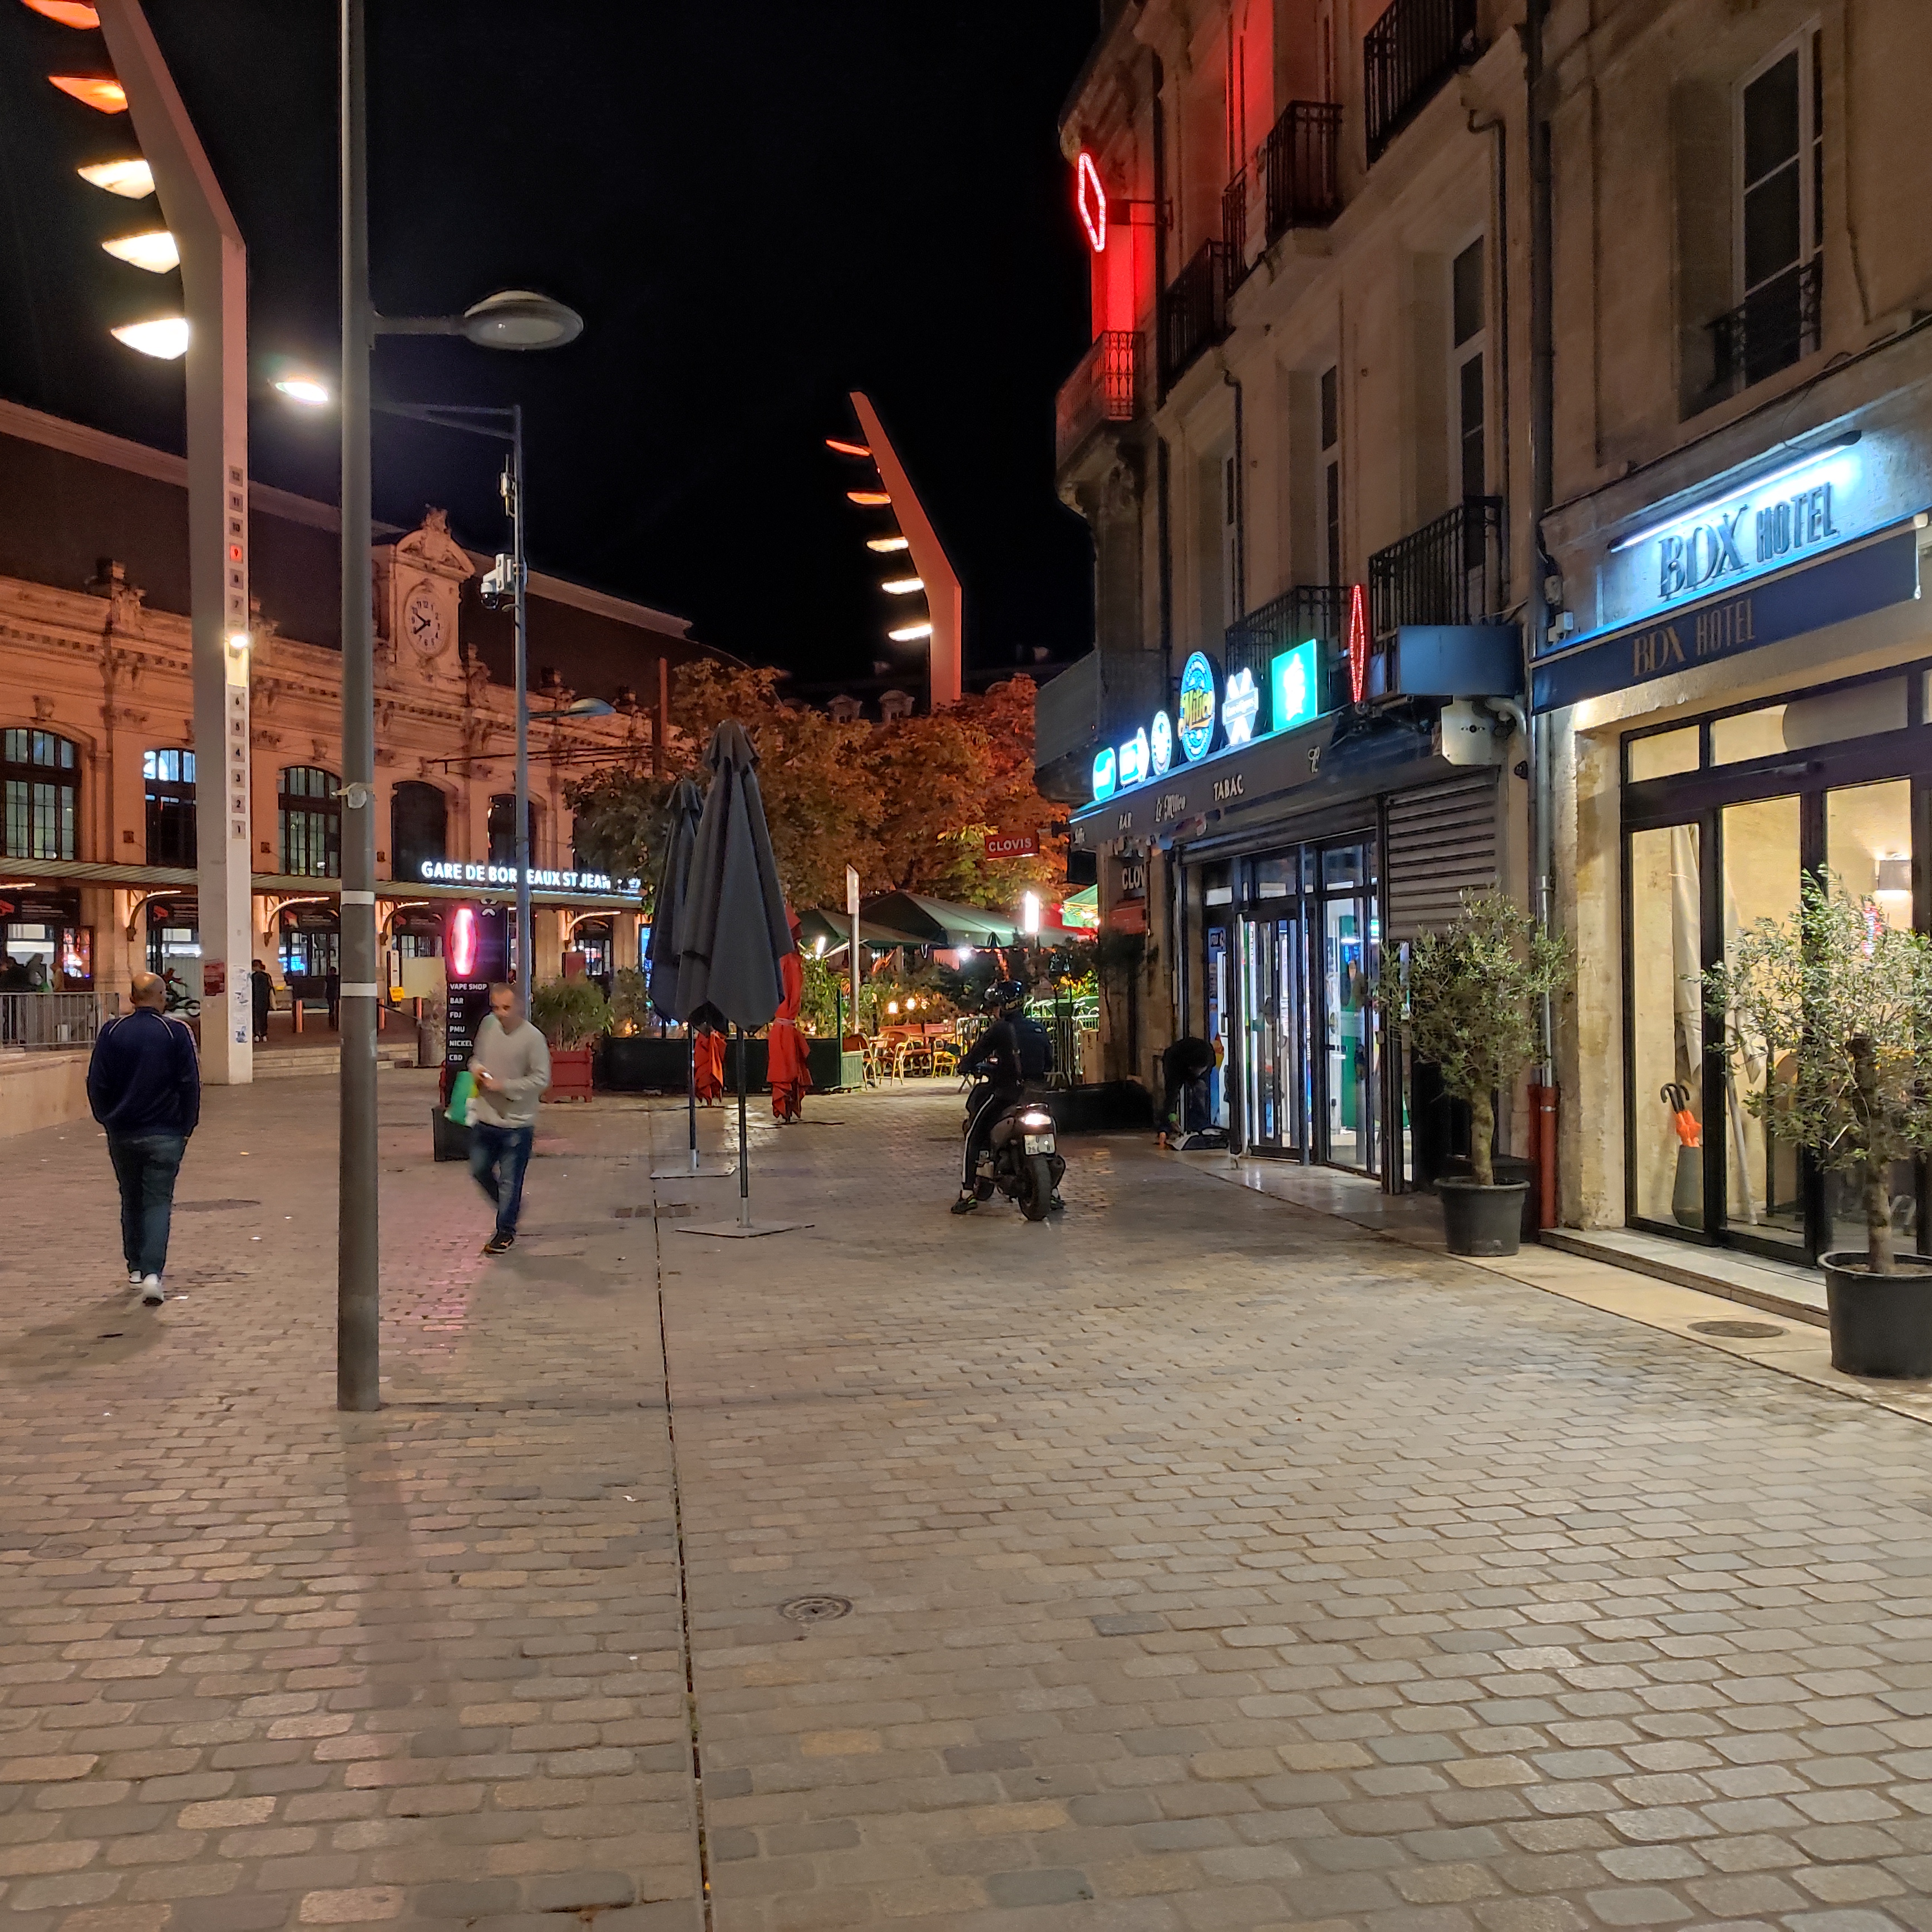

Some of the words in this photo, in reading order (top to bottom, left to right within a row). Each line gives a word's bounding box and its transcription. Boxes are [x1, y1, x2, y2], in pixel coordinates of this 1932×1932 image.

[233, 522, 240, 533] 10
[1658, 504, 1749, 600] BDX
[1756, 482, 1840, 563] HOTEL
[1696, 598, 1755, 657] HOTEL
[1214, 773, 1244, 801] TABAC
[1118, 812, 1132, 830] BAR
[1155, 797, 1162, 822] Le
[988, 837, 1032, 852] CLOVIS
[421, 861, 462, 880] GARE
[465, 864, 485, 881] DE
[489, 866, 560, 886] BOREAUX
[563, 871, 578, 887] ST
[579, 873, 611, 889] JEAN
